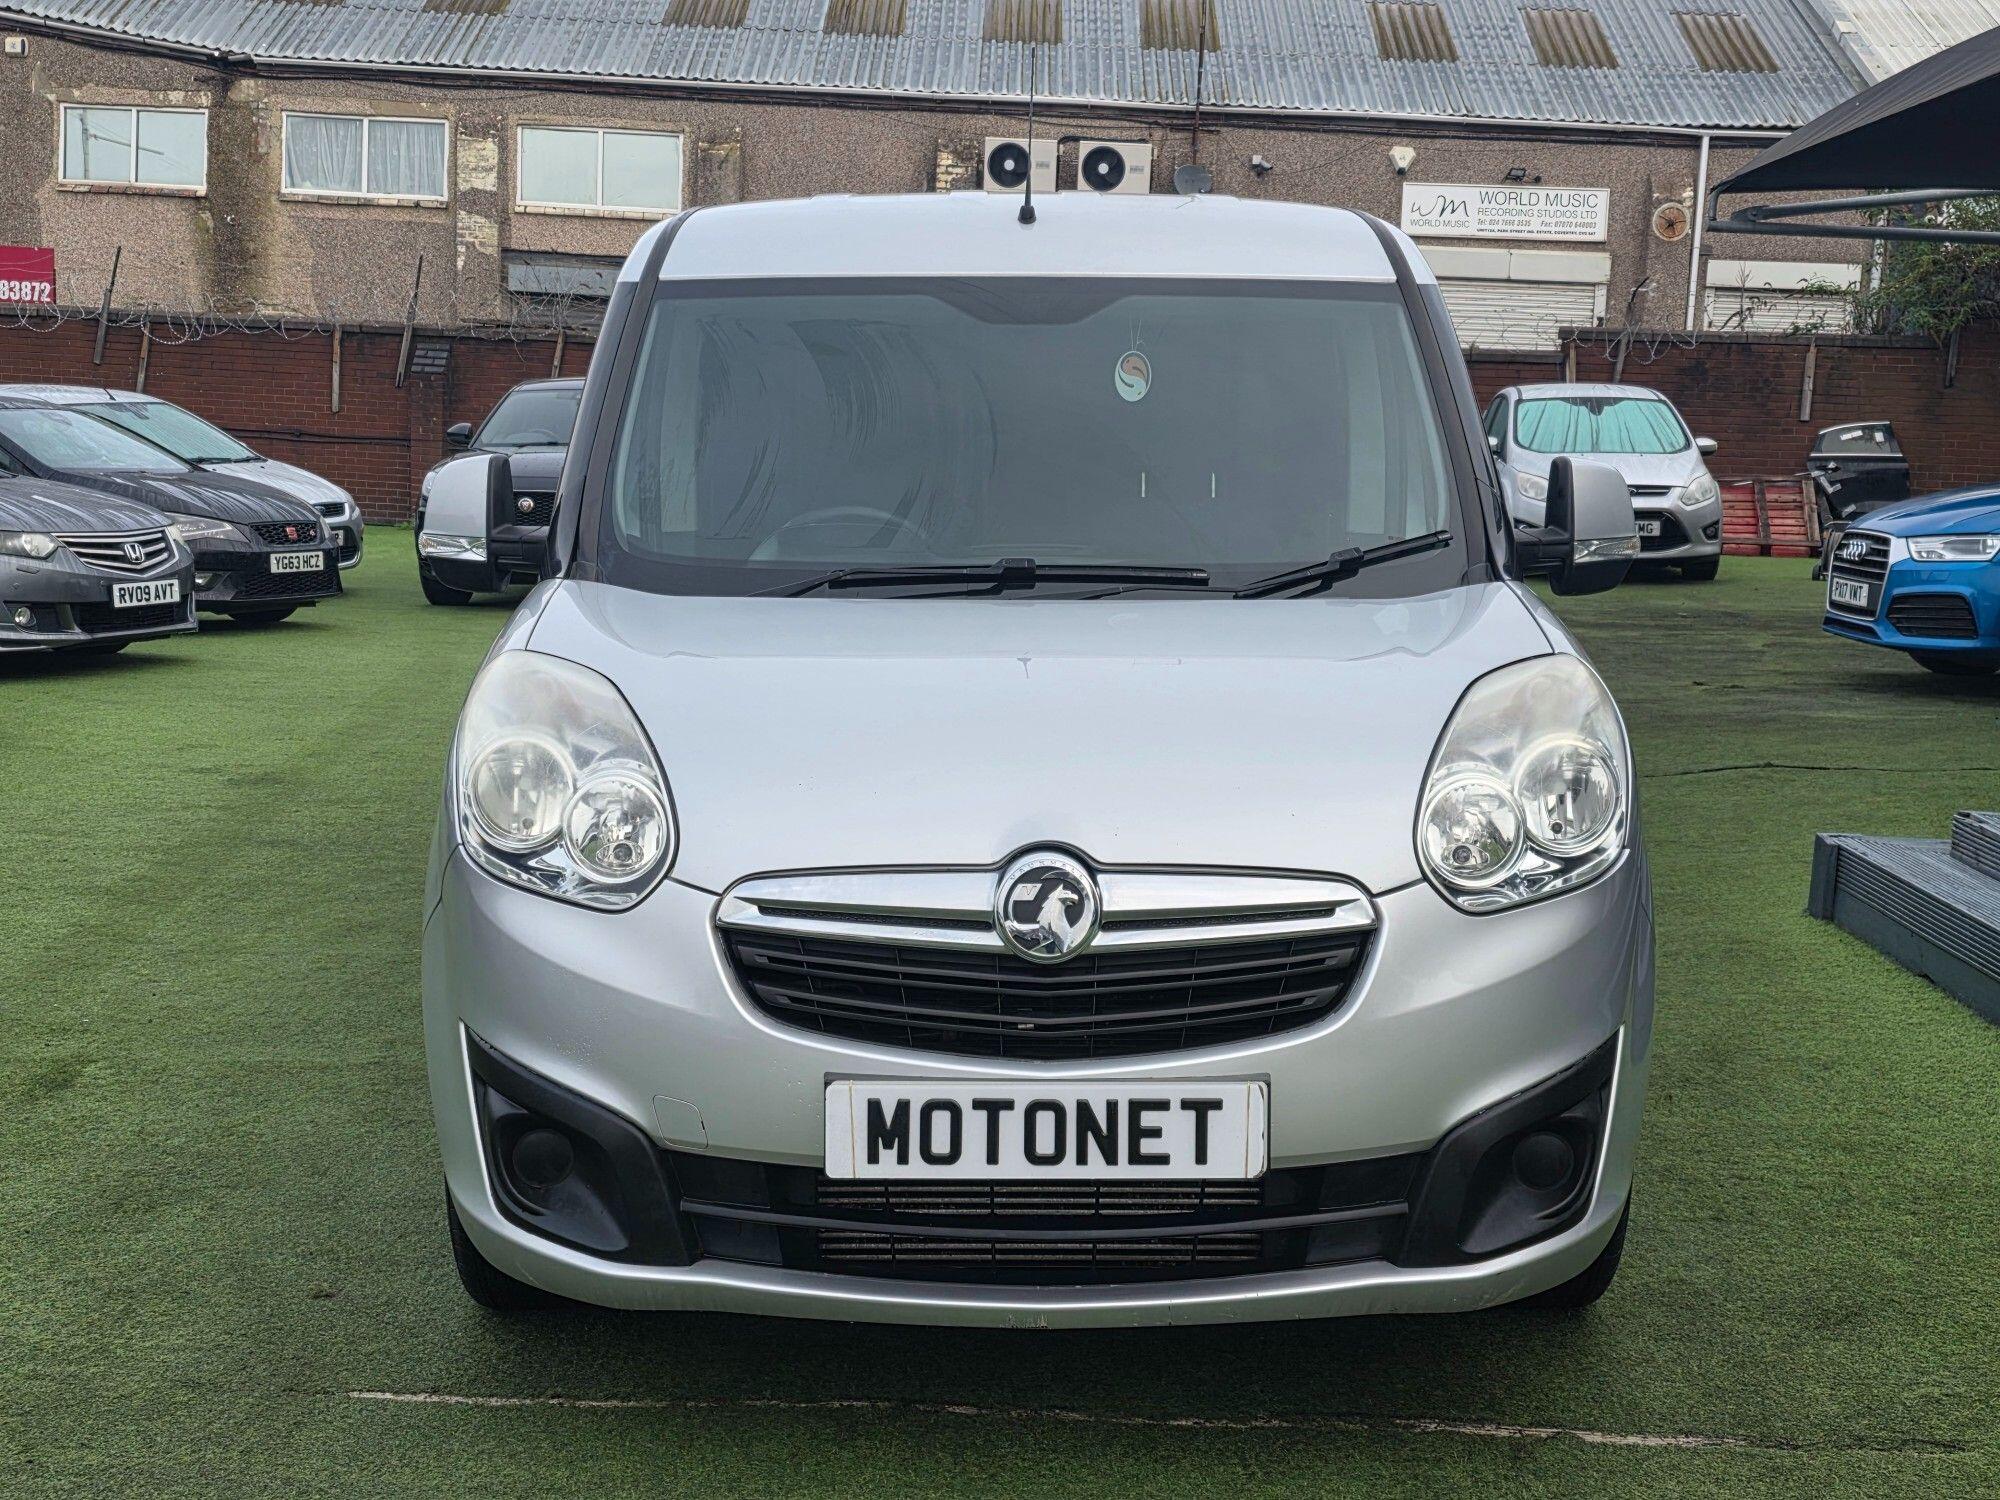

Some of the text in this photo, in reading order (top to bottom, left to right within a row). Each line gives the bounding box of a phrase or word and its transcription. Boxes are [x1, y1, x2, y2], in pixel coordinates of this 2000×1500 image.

[1479, 190, 1598, 208] WORLD MUSIC
[1477, 207, 1598, 220] RECORDING STUDIOS LTD
[1410, 218, 1470, 229] WORLD MUSIC
[274, 554, 320, 571] YG63 HCZ
[118, 582, 174, 604] RV09 AVT
[867, 1098, 1223, 1166] MOTONET
